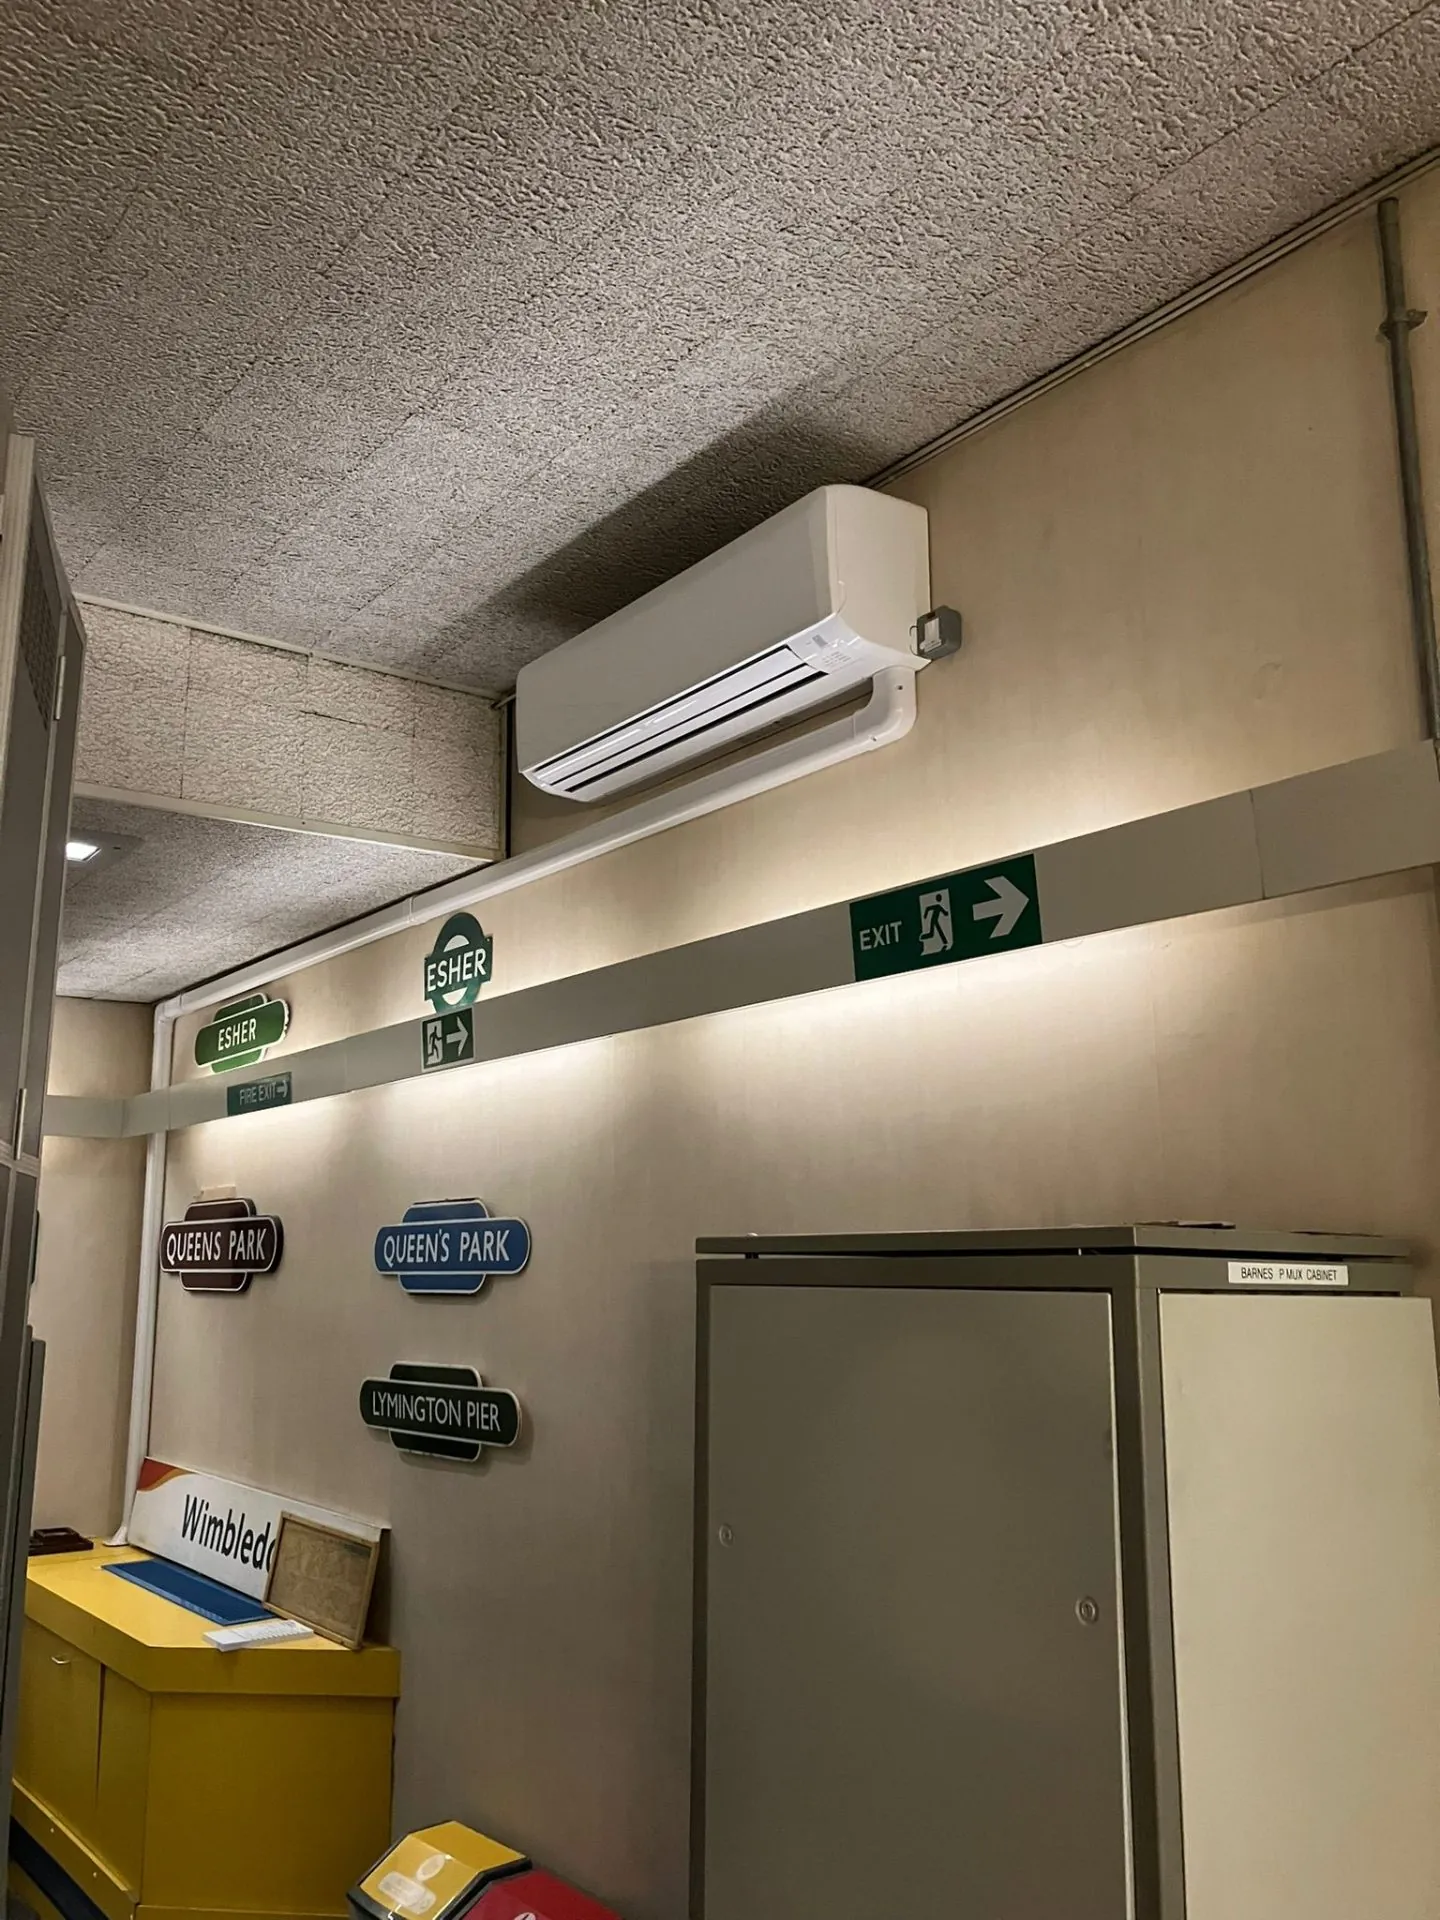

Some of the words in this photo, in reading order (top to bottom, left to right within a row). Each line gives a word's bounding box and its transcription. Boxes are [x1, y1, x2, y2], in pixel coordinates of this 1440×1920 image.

[859, 920, 902, 951] EXIT
[427, 948, 487, 992] ESHER
[217, 1018, 257, 1052] ESHER
[239, 1086, 257, 1106] FIRE
[258, 1081, 277, 1102] EXIT
[166, 1231, 221, 1265] QUEENS
[228, 1228, 266, 1261] PARK
[383, 1228, 450, 1268] QUEEN'S
[459, 1229, 510, 1262] PARK
[1241, 1267, 1273, 1280] BARNES
[1306, 1269, 1337, 1281] CABINET
[372, 1391, 461, 1427] LYMINGTON
[466, 1402, 501, 1432] PIER
